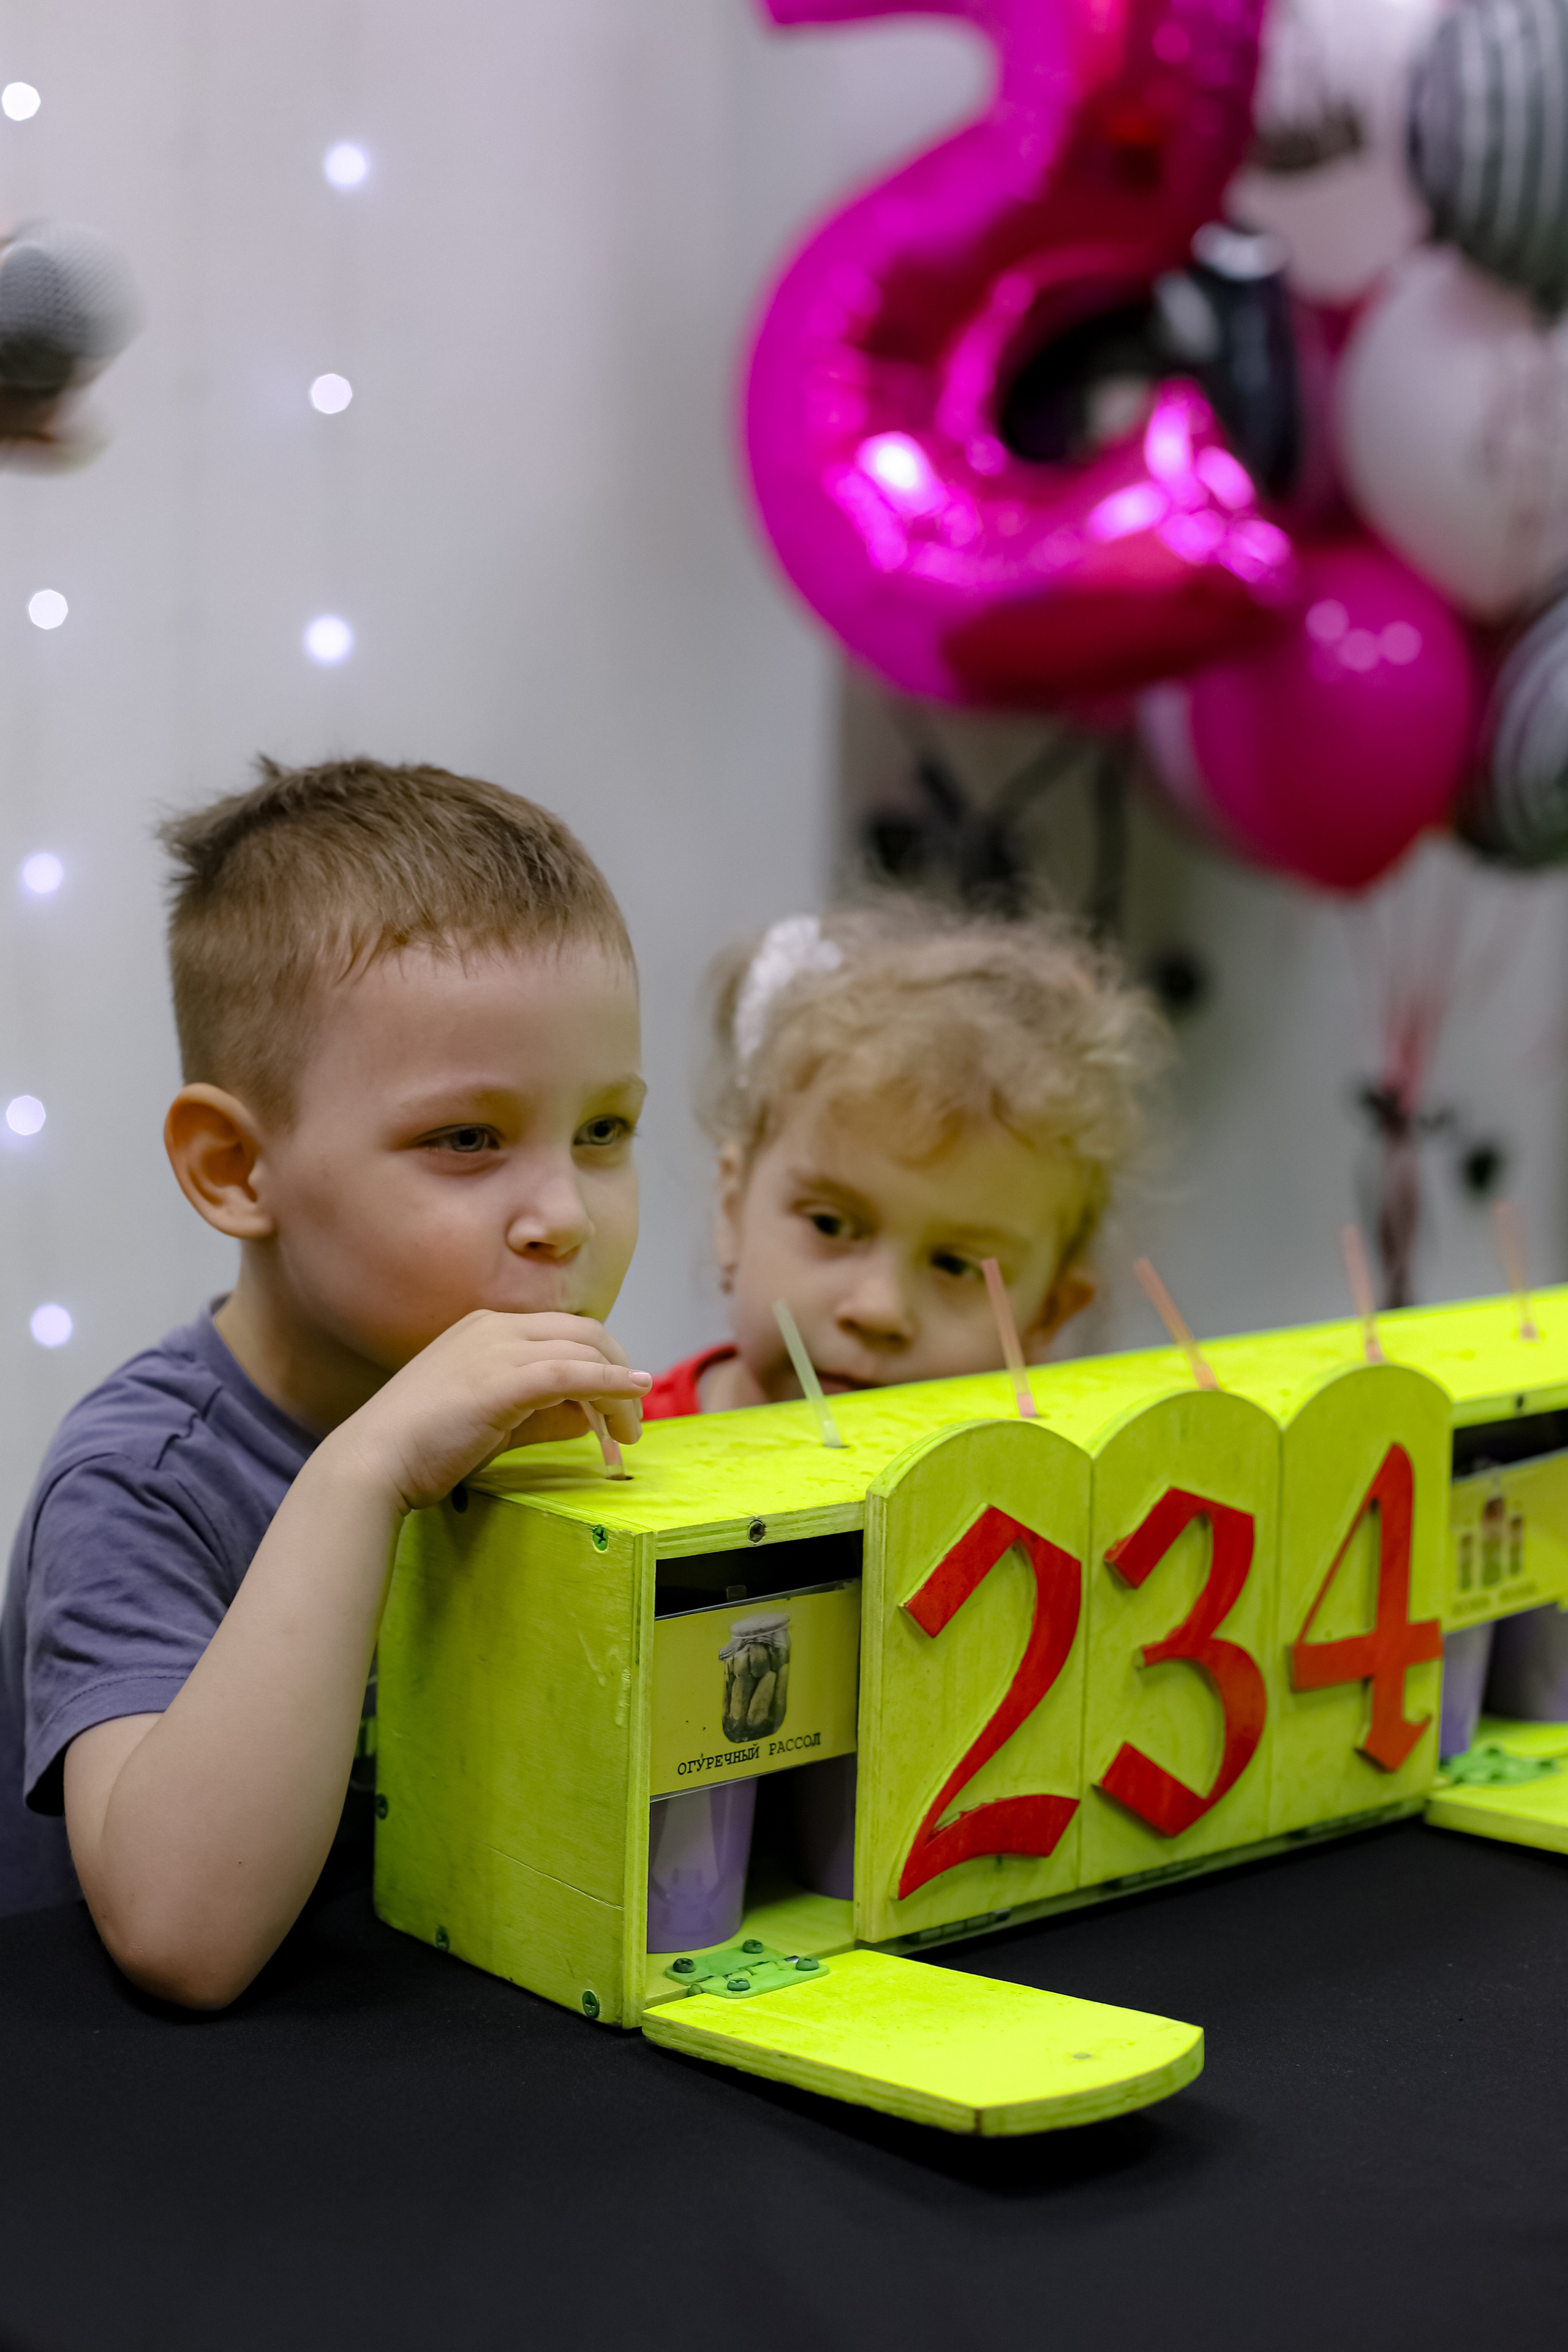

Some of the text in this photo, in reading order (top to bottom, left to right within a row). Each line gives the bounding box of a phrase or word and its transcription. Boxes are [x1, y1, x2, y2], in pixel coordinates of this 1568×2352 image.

[677, 1733, 821, 1775] ОГУРЕЧНЫЙ РАССОЛ
[898, 1442, 1444, 1900] 2 3 4
